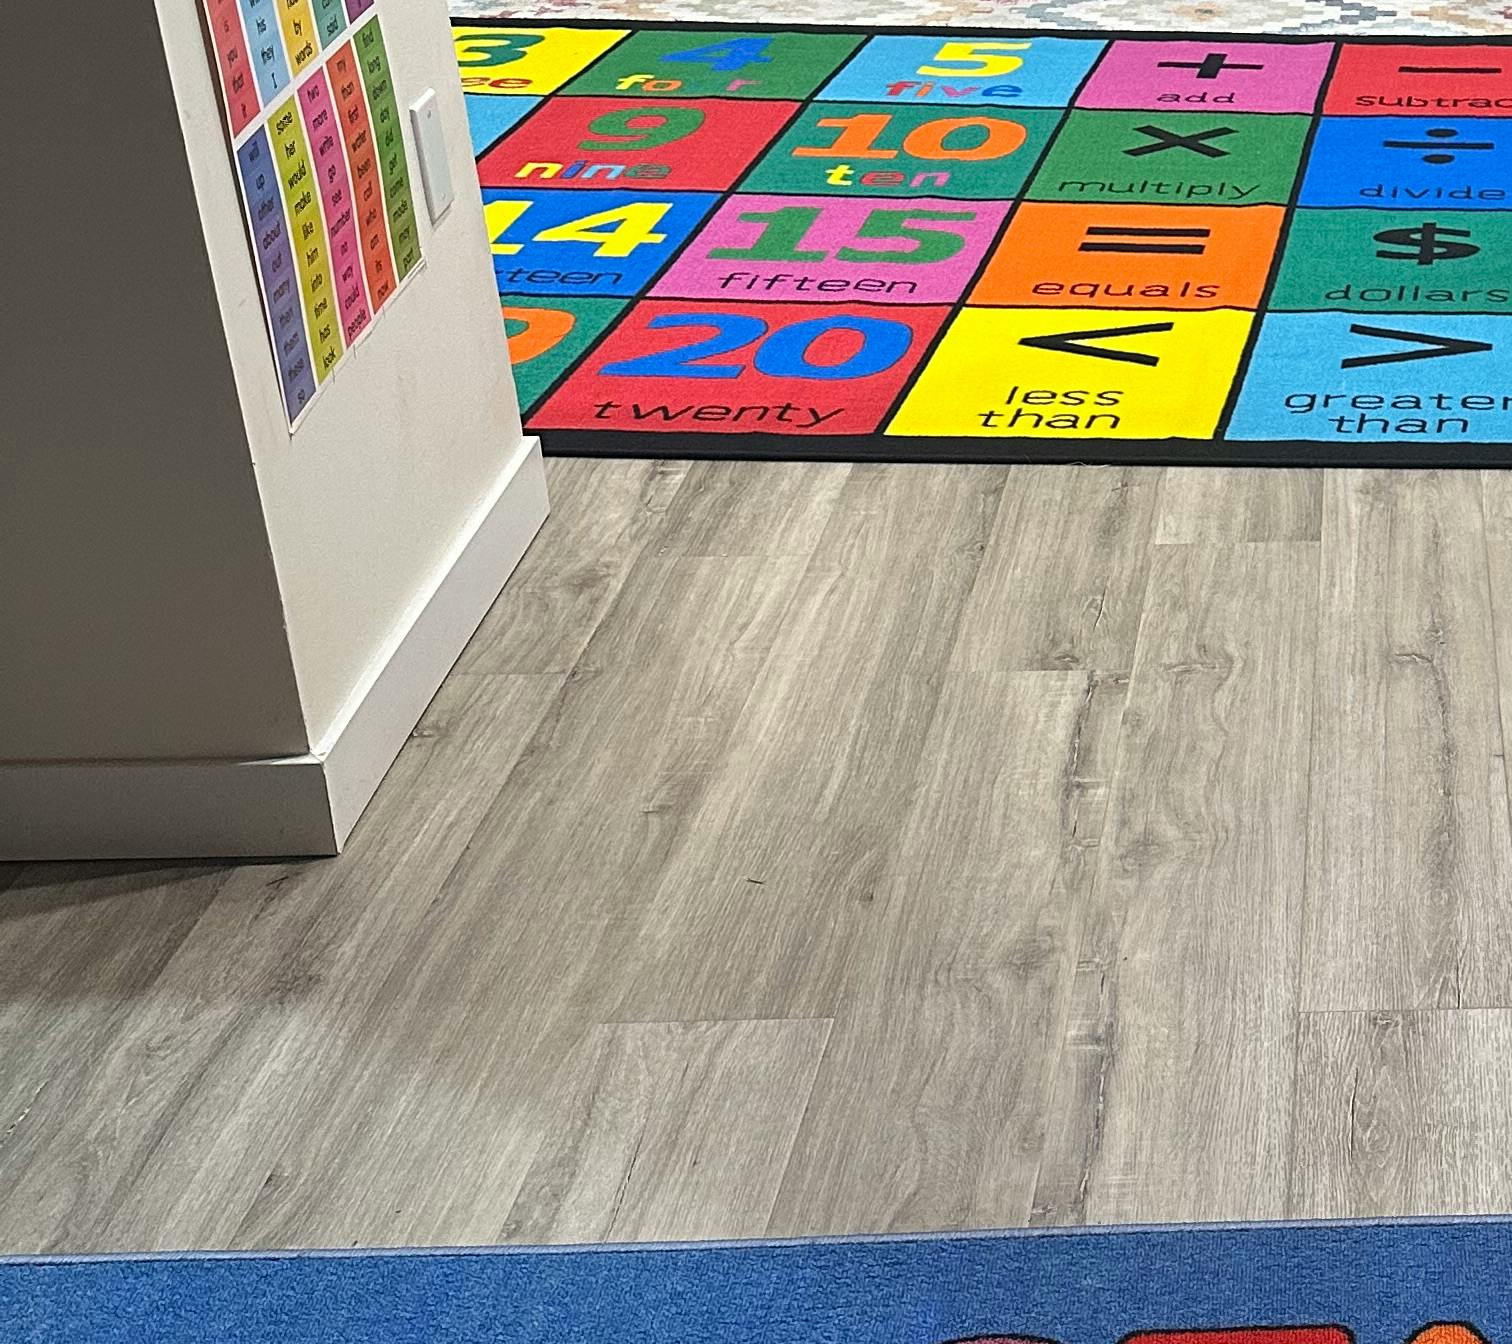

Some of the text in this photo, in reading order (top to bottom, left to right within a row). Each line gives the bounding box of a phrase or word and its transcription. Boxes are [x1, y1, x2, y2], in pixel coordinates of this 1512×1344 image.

[660, 36, 773, 72] 4
[916, 42, 1032, 77] 5
[886, 81, 1023, 98] five
[1156, 91, 1236, 104] add
[577, 107, 705, 152] 9
[791, 113, 1027, 161] 10
[514, 160, 672, 180] nine
[825, 164, 951, 187] ten
[1058, 179, 1261, 201] multiply
[1360, 183, 1507, 200] divide
[484, 200, 673, 258] 14
[707, 207, 976, 263] 15
[717, 272, 918, 295] fifteen
[1031, 281, 1221, 302] equals
[1325, 285, 1510, 303] dollars
[599, 313, 914, 380] 20
[1004, 386, 1125, 406] less
[594, 401, 845, 427] twenty
[978, 410, 1121, 431] than
[1330, 413, 1470, 435] than
